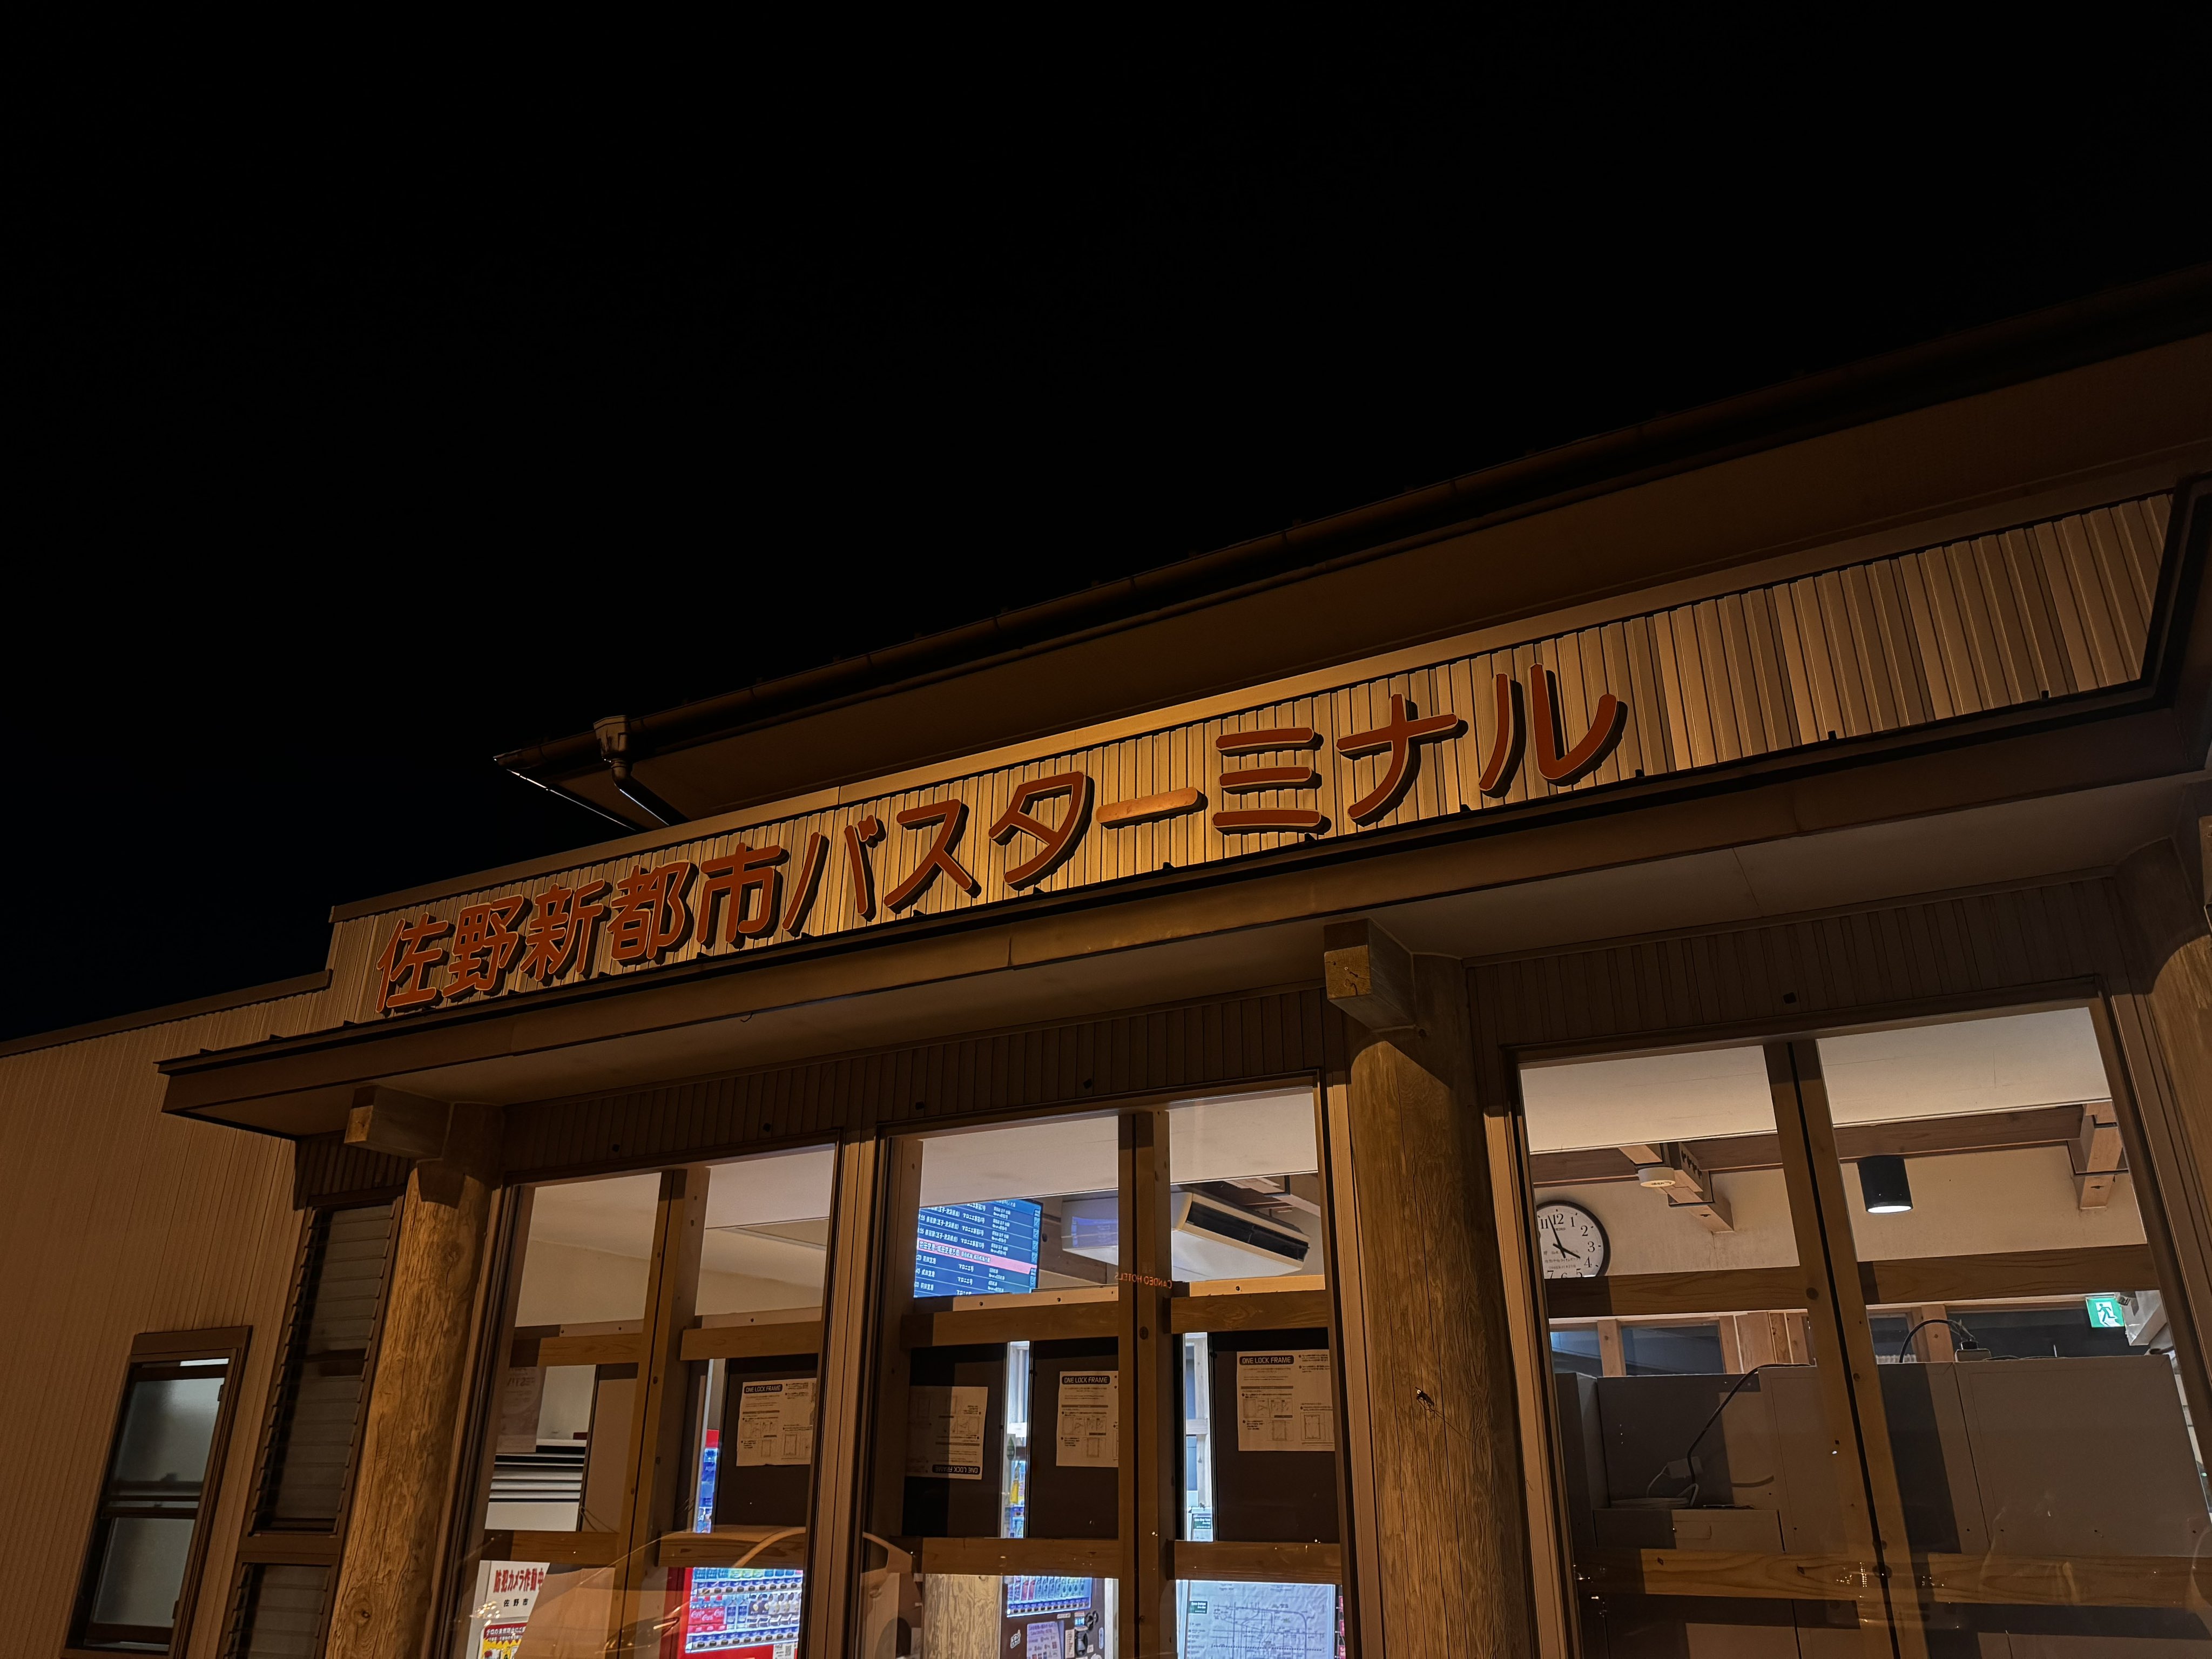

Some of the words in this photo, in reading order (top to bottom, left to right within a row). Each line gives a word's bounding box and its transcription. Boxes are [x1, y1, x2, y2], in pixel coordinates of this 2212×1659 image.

[376, 664, 1618, 1013] 佐野新都市バスターミナル
[1541, 1219, 1549, 1229] 11
[1553, 1213, 1564, 1225] 12
[1570, 1217, 1575, 1227] 1
[1581, 1225, 1588, 1236] 2
[1588, 1242, 1595, 1252] 3
[1584, 1257, 1592, 1267] 4
[1547, 1270, 1554, 1279] 7
[1576, 1269, 1583, 1278] 5
[503, 1598, 529, 1607] 佐野市
